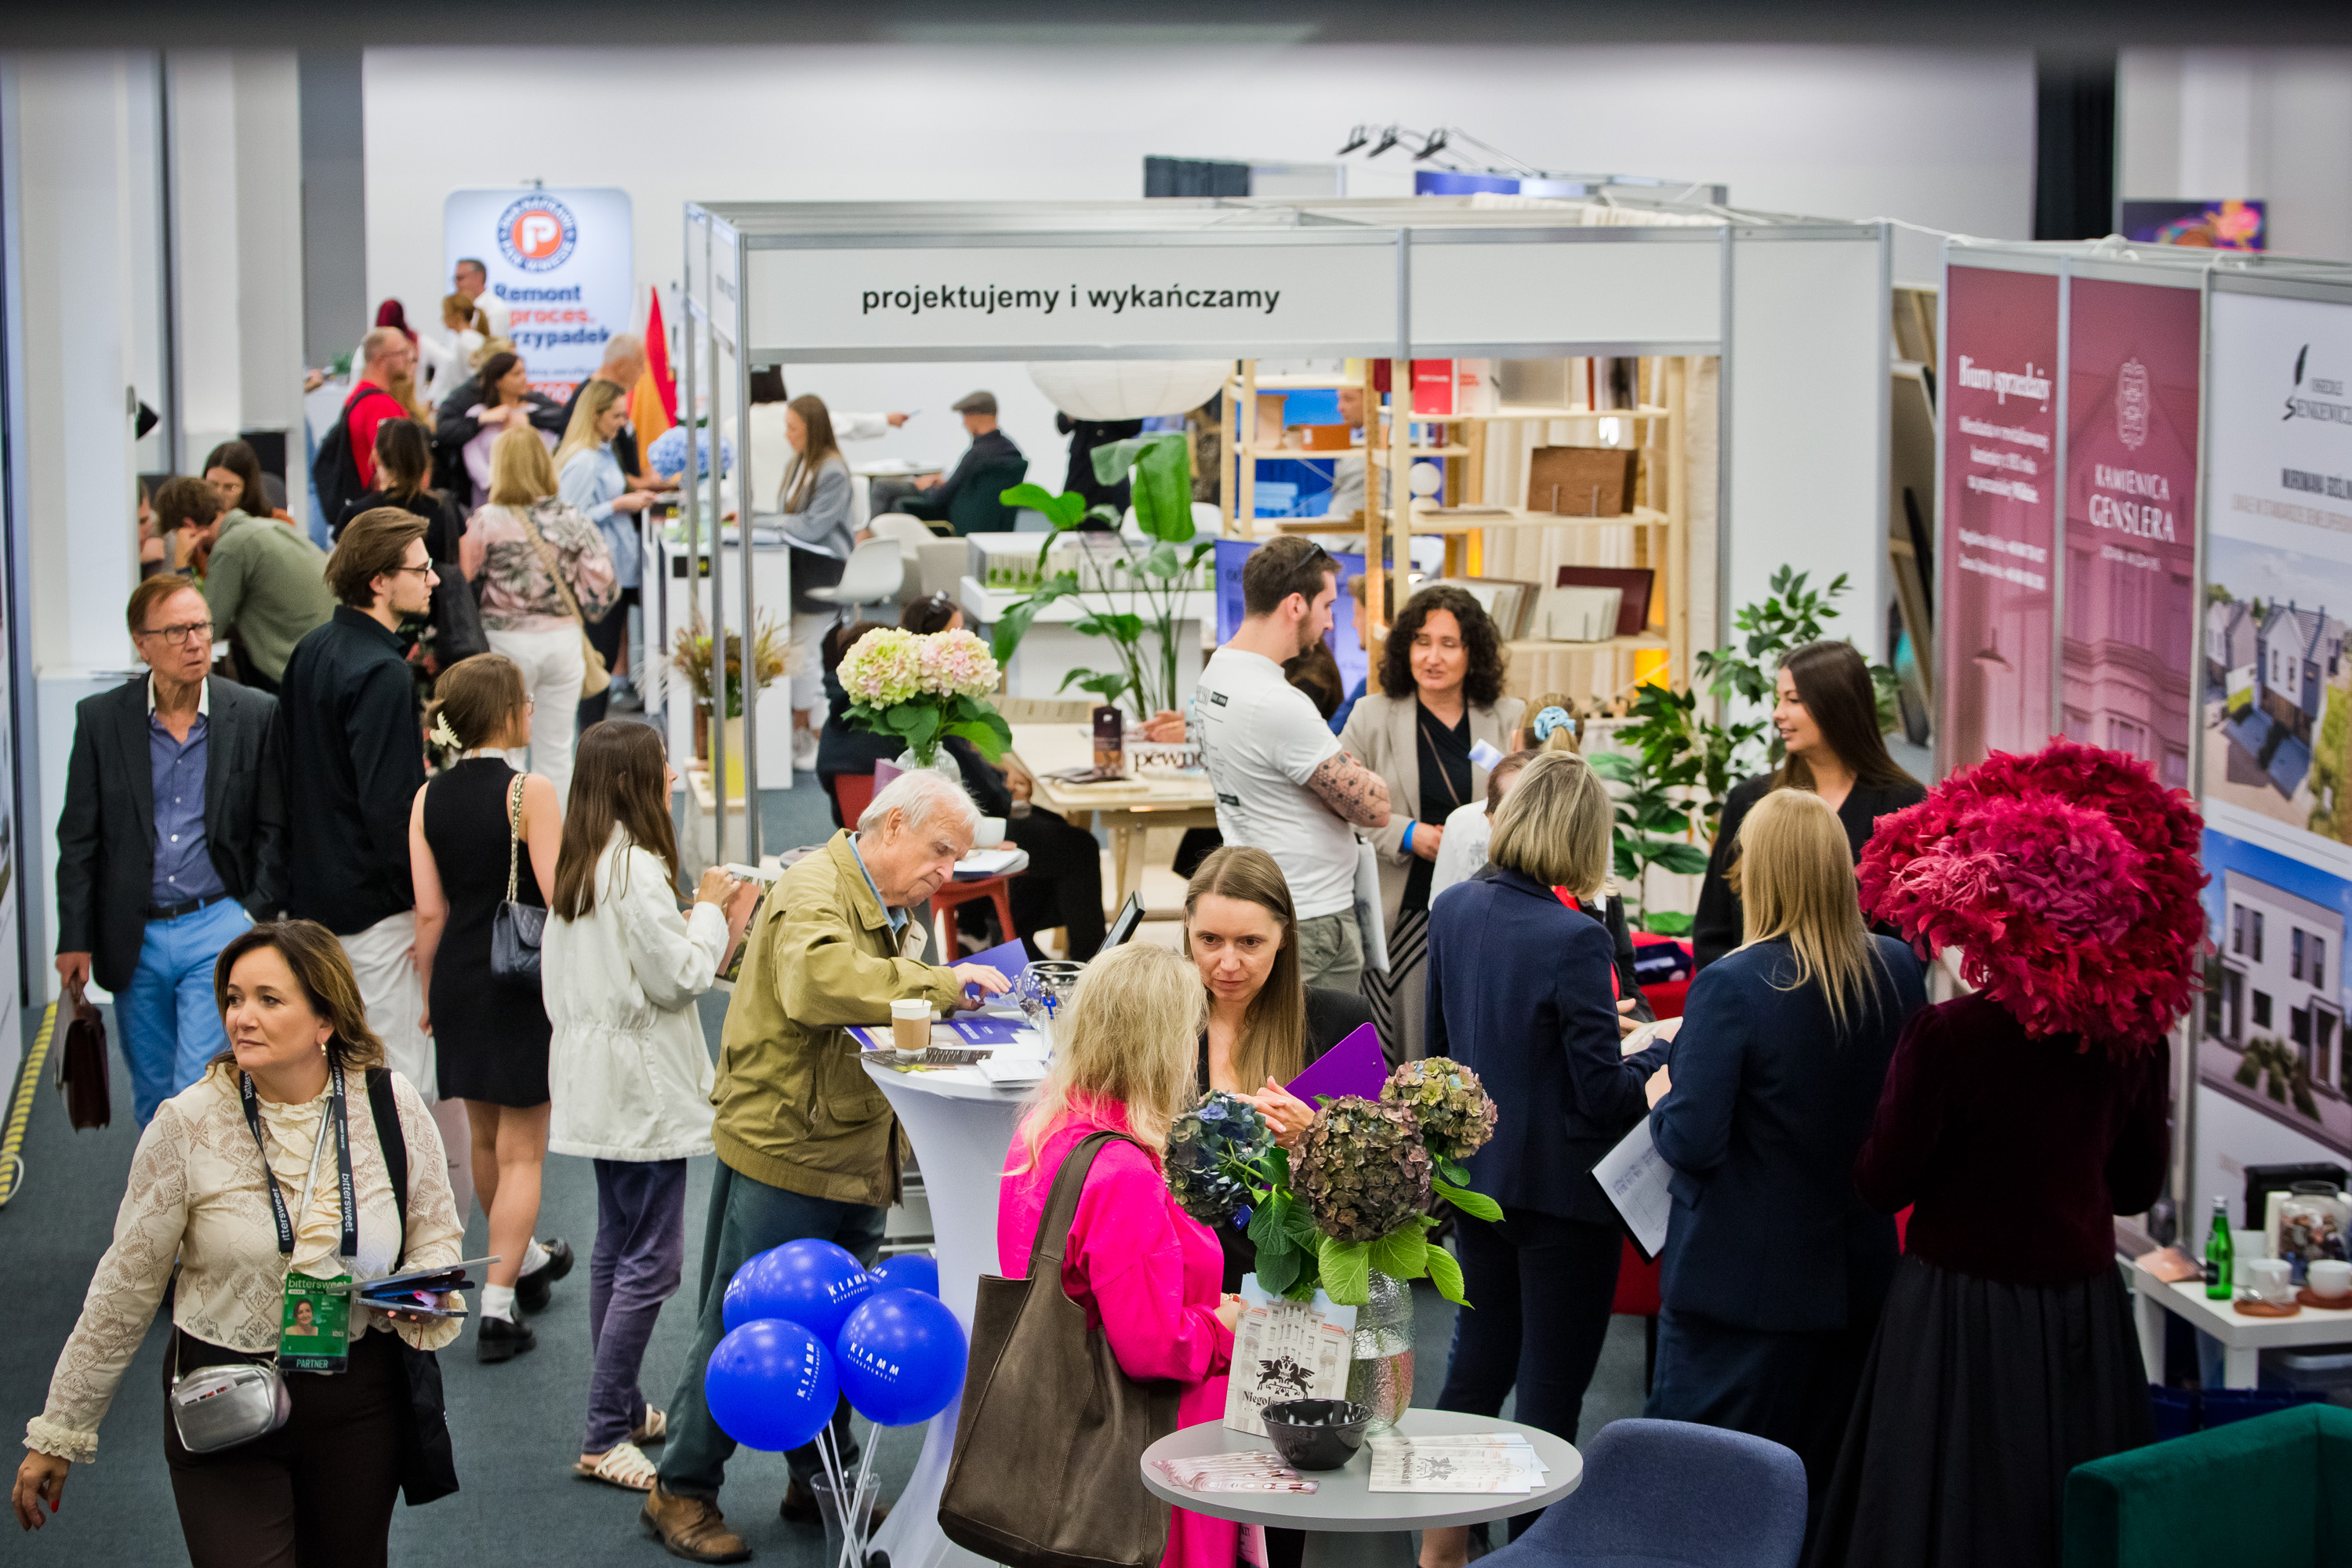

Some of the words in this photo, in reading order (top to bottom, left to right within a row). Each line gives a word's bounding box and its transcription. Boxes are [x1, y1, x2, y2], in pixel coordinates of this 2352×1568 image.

[495, 285, 581, 301] Remont
[863, 285, 1059, 314] projektujemy
[1071, 285, 1076, 307] i
[1088, 283, 1279, 314] wykańczamy
[510, 325, 610, 349] rzypadek
[2095, 463, 2170, 502] KAMIENICA
[2089, 494, 2176, 543] GENSLERA
[272, 1188, 290, 1241] ittersweet
[342, 1173, 354, 1233] bittersweet
[296, 1359, 328, 1369] PARTNER
